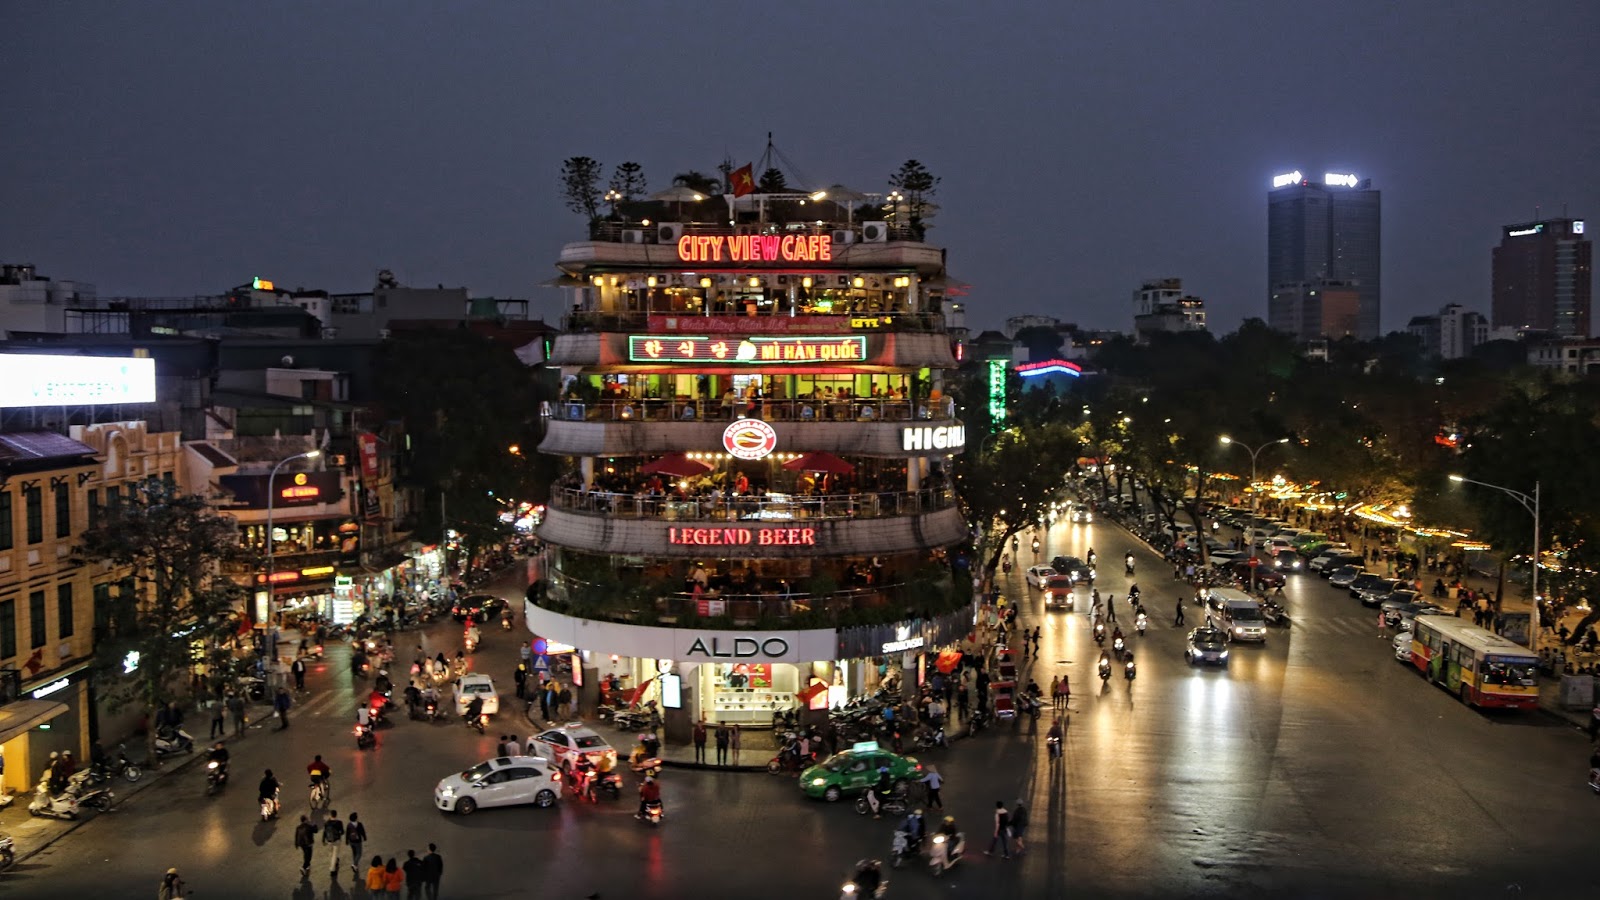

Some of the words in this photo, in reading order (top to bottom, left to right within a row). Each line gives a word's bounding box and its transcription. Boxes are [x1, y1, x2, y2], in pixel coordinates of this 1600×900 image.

[678, 235, 724, 262] CITY
[727, 235, 781, 262] VIEW
[781, 235, 832, 262] CAFE
[761, 340, 781, 360] MÌ
[783, 340, 816, 360] HÀN
[820, 338, 859, 360] QUỐC
[669, 527, 752, 545] LEGEND
[758, 527, 815, 546] BEER
[686, 637, 789, 658] ALDO
